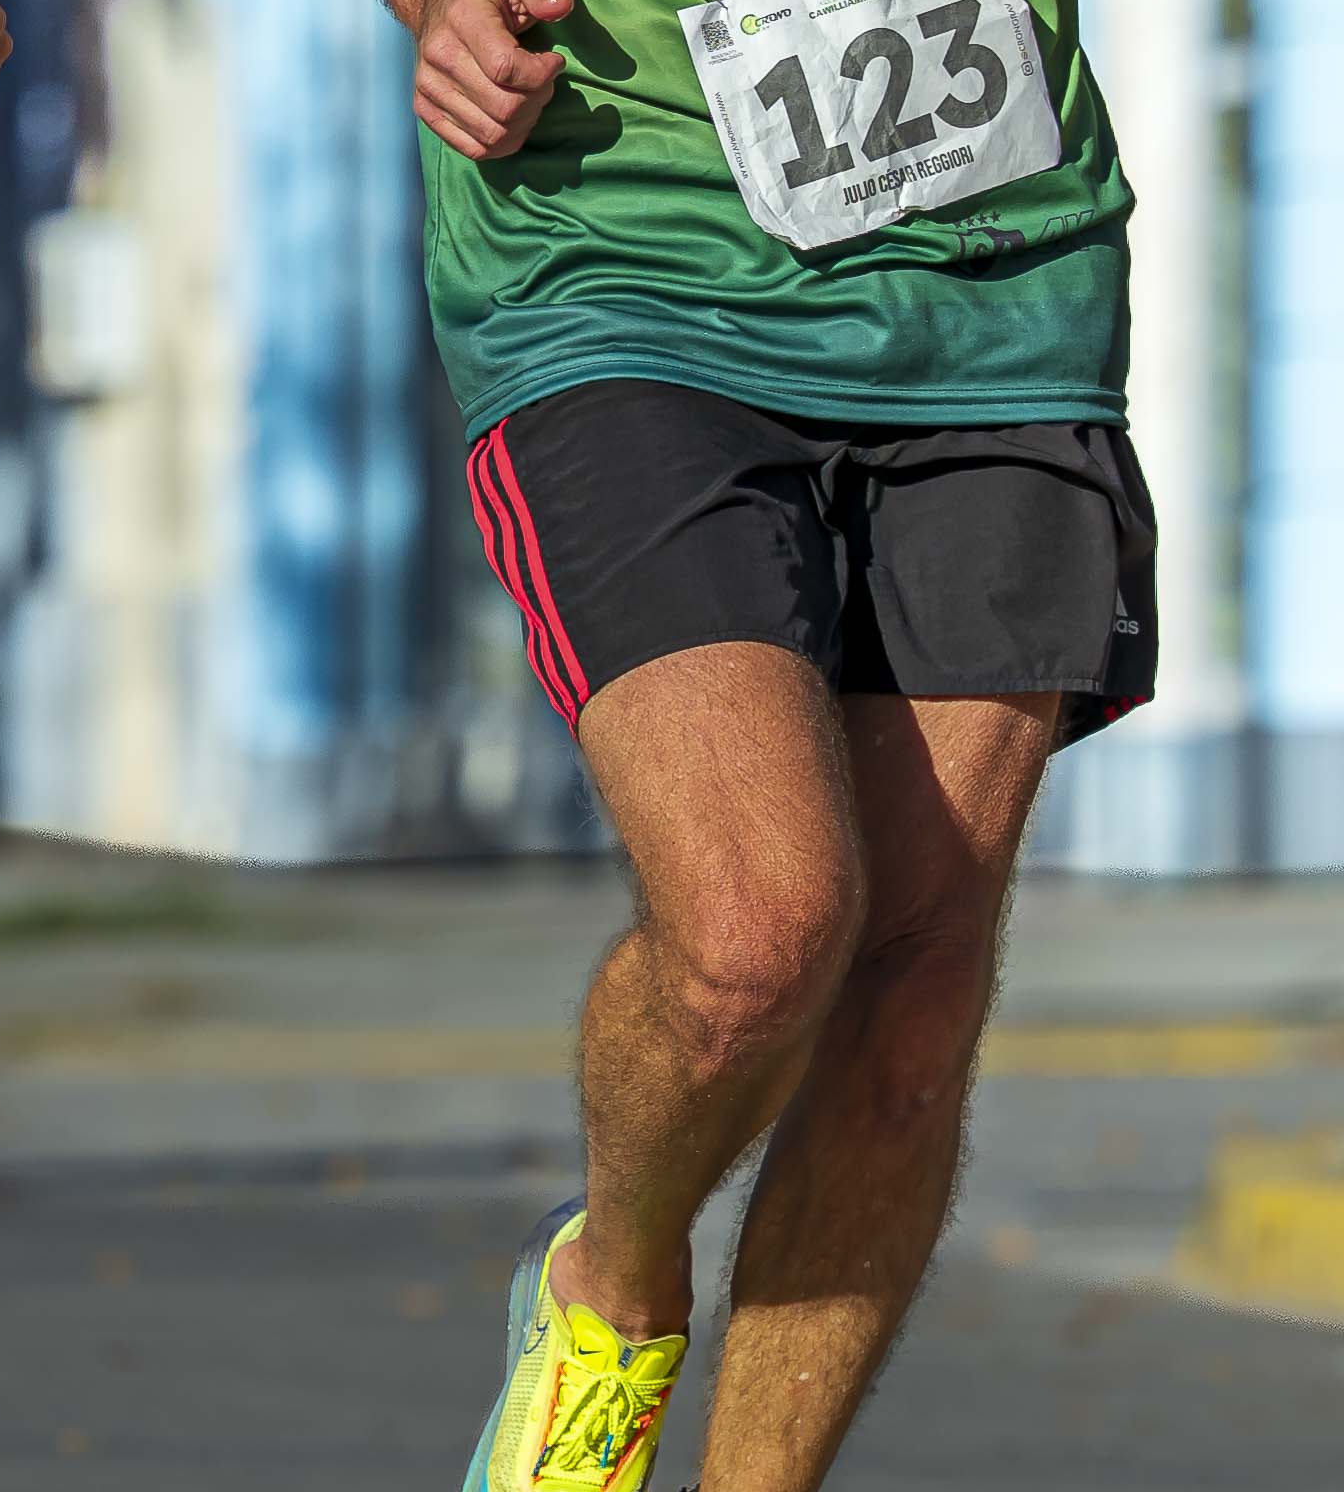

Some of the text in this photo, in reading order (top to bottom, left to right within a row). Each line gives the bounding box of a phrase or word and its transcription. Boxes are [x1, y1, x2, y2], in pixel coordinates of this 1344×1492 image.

[843, 145, 975, 206] JULIO CÉSAR REGGIORI
